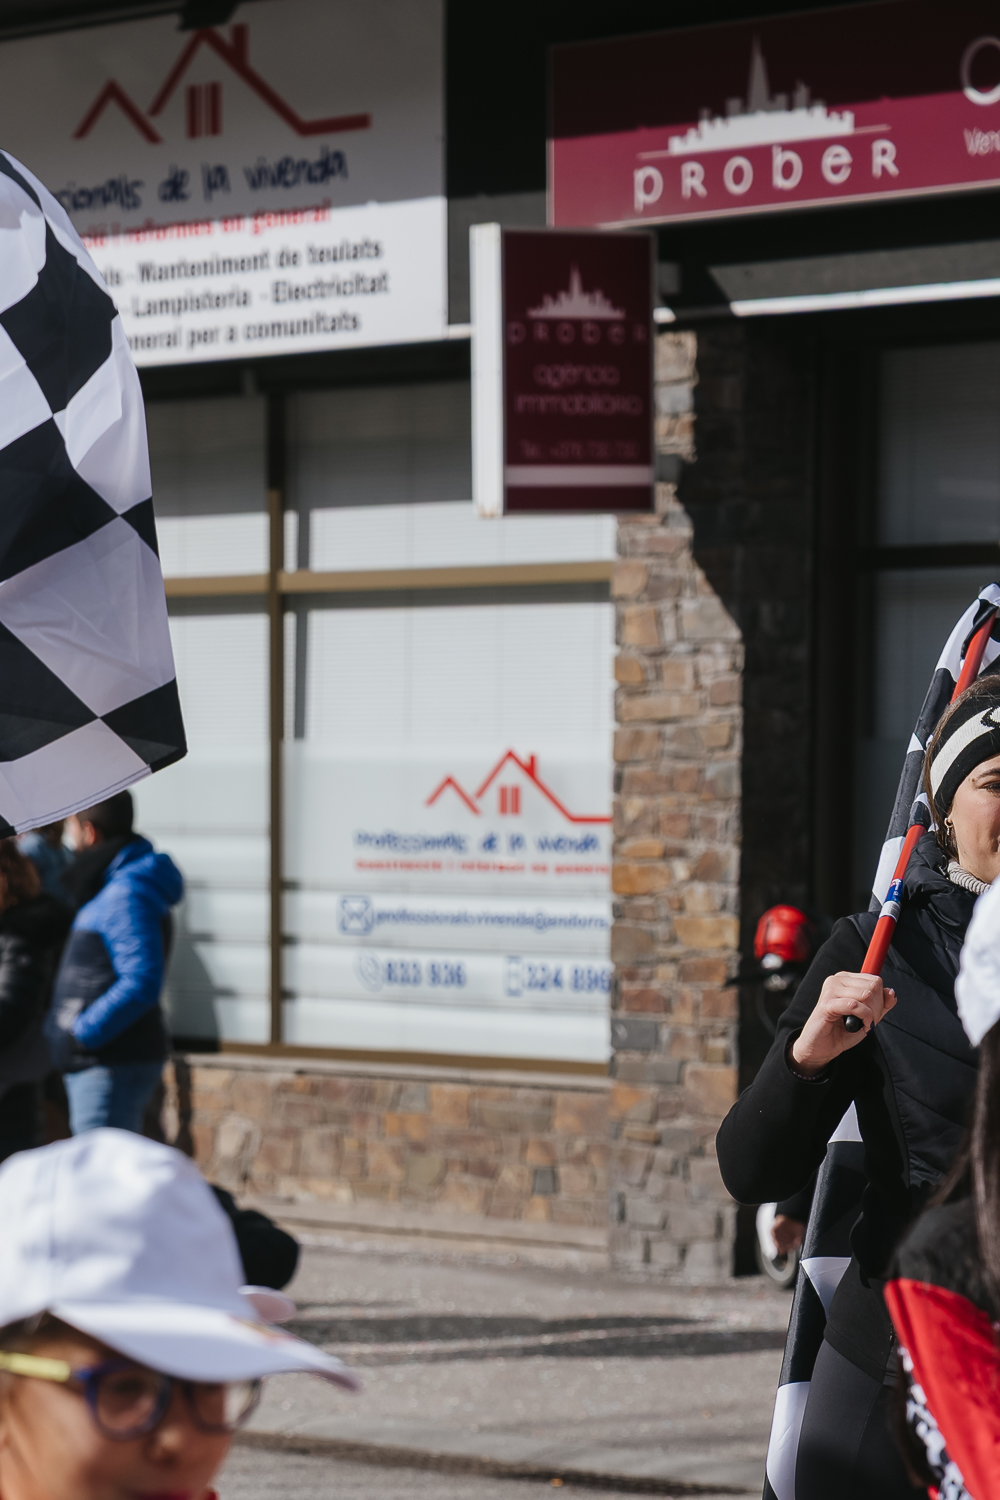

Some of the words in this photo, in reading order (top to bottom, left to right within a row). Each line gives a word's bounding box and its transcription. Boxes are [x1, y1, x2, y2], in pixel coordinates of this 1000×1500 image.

[159, 164, 189, 201] de
[243, 147, 348, 190] vivenda
[128, 212, 212, 244] reformes
[220, 212, 243, 233] en
[252, 199, 332, 236] general
[138, 251, 270, 284] Manteniment
[277, 246, 298, 268] de
[309, 240, 382, 265] teulats
[133, 289, 250, 319] Lampisteria
[273, 271, 389, 303] Electricitat
[189, 325, 219, 351] per
[226, 324, 238, 343] a
[244, 311, 360, 340] comunitats
